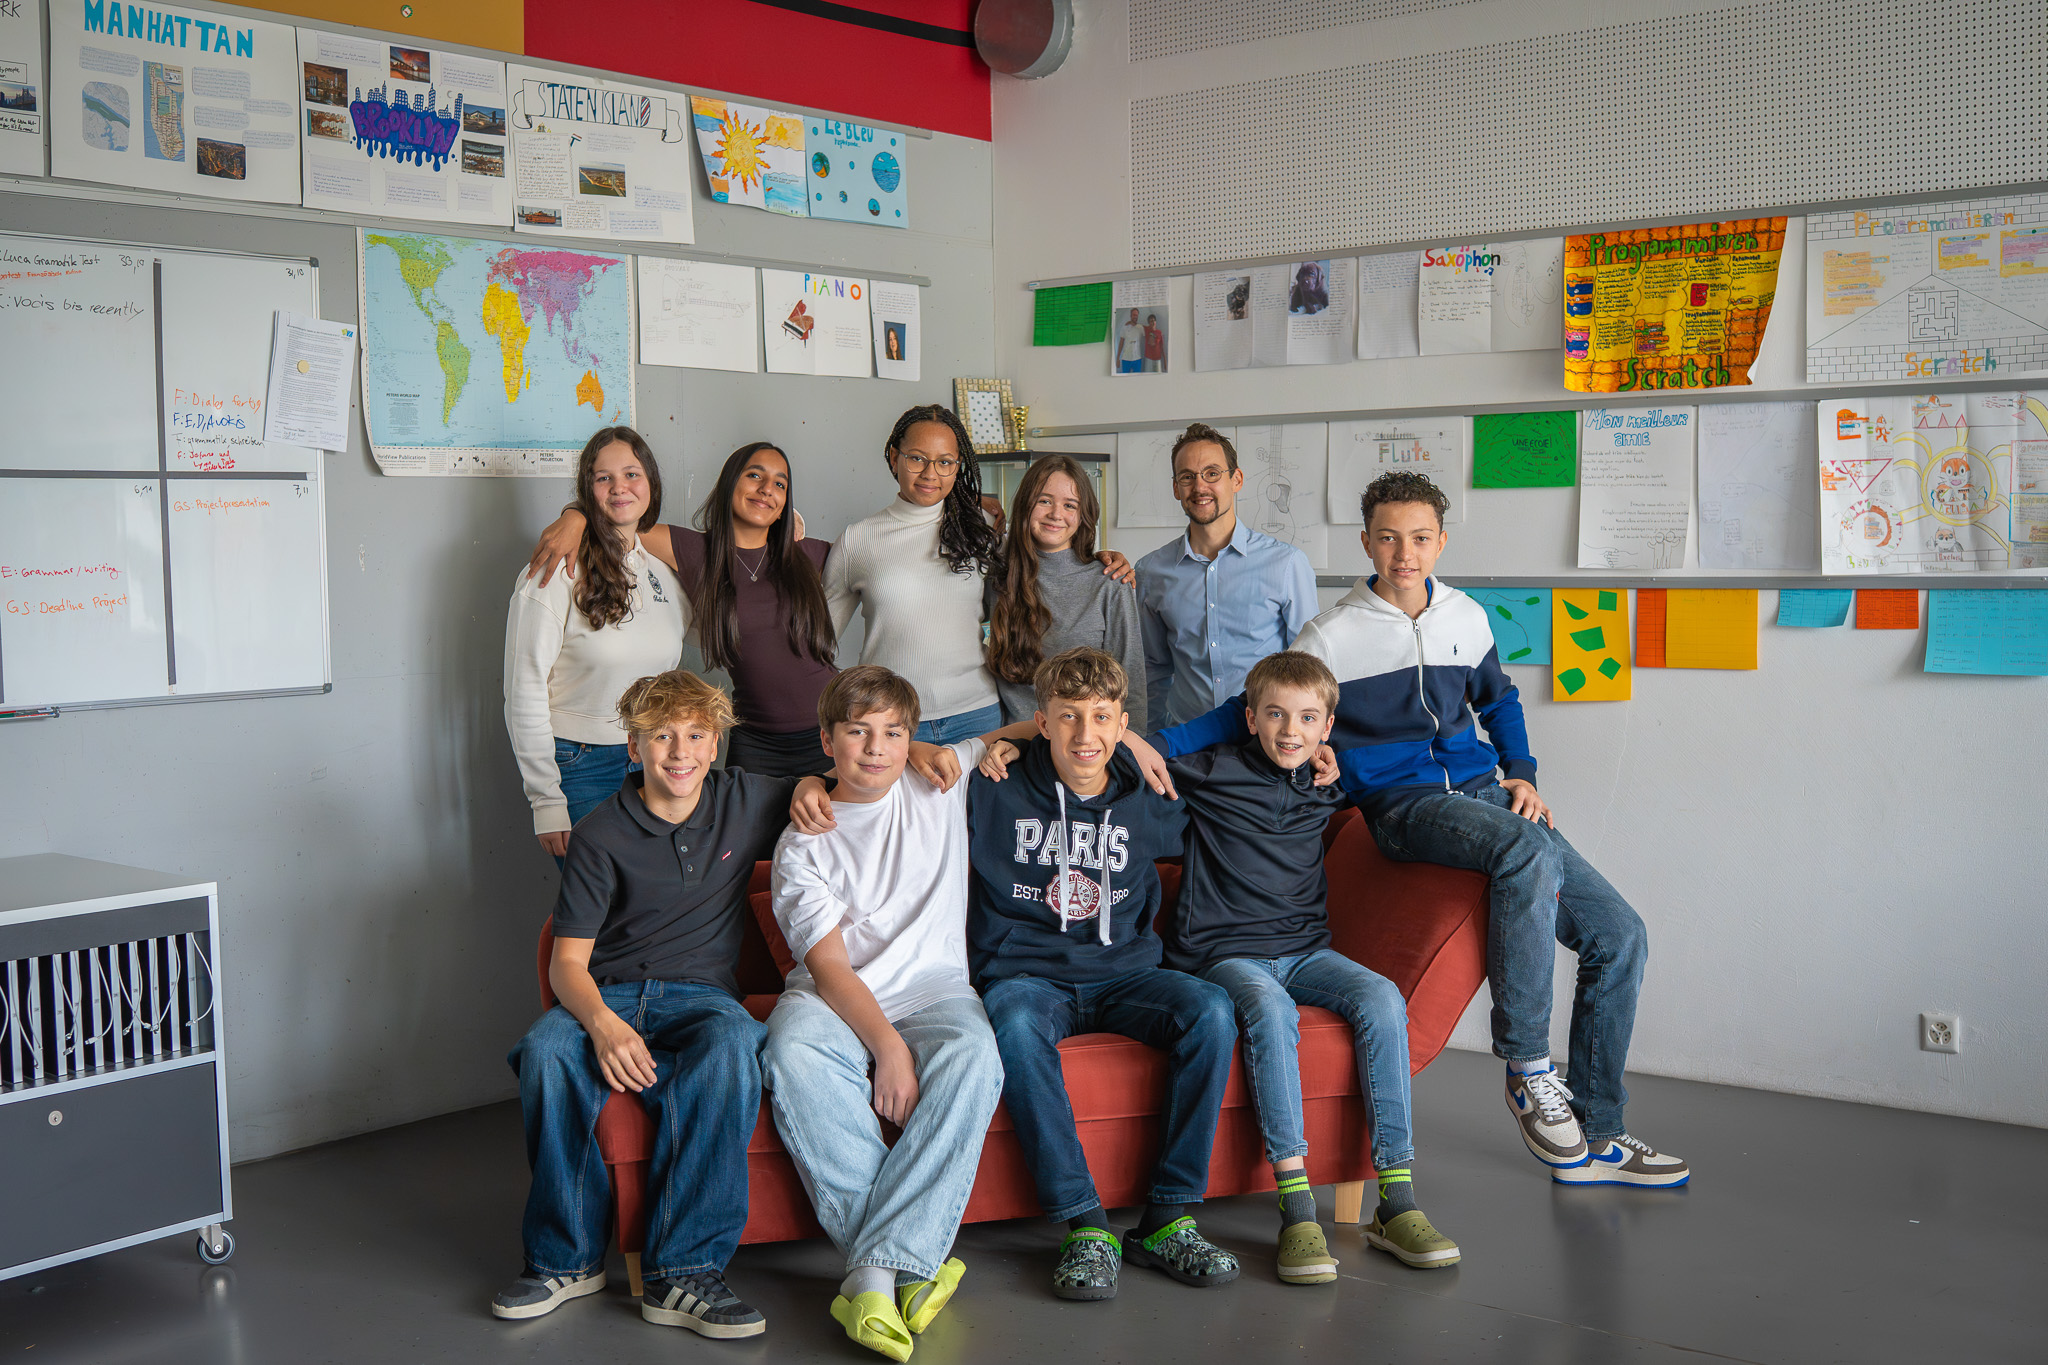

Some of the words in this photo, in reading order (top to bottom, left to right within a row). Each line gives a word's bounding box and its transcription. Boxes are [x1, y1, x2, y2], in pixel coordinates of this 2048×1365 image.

[84, 0, 254, 59] MANHATTAN
[537, 81, 597, 123] STATEN
[601, 90, 651, 128] ISLAND
[350, 102, 459, 154] BROOKLYN
[824, 118, 841, 136] Le
[3, 249, 31, 264] Luca
[34, 254, 77, 267] Gramatik
[80, 254, 101, 266] Test
[1422, 247, 1501, 273] Saxophon
[63, 298, 83, 312] bis
[89, 300, 145, 323] recently
[1618, 354, 1731, 391] Scratch
[1904, 348, 1998, 377] Scratch
[1585, 408, 1624, 431] Mon
[1626, 409, 1689, 429] meilleur
[1378, 440, 1431, 463] Flute
[173, 500, 195, 513] GS:
[1, 566, 18, 578] E:
[6, 599, 36, 616] GS:
[39, 598, 85, 614] Deadline
[92, 593, 128, 614] Project
[1013, 818, 1130, 873] PARIS
[1012, 883, 1044, 902] EST.
[1067, 909, 1088, 918] ARIS
